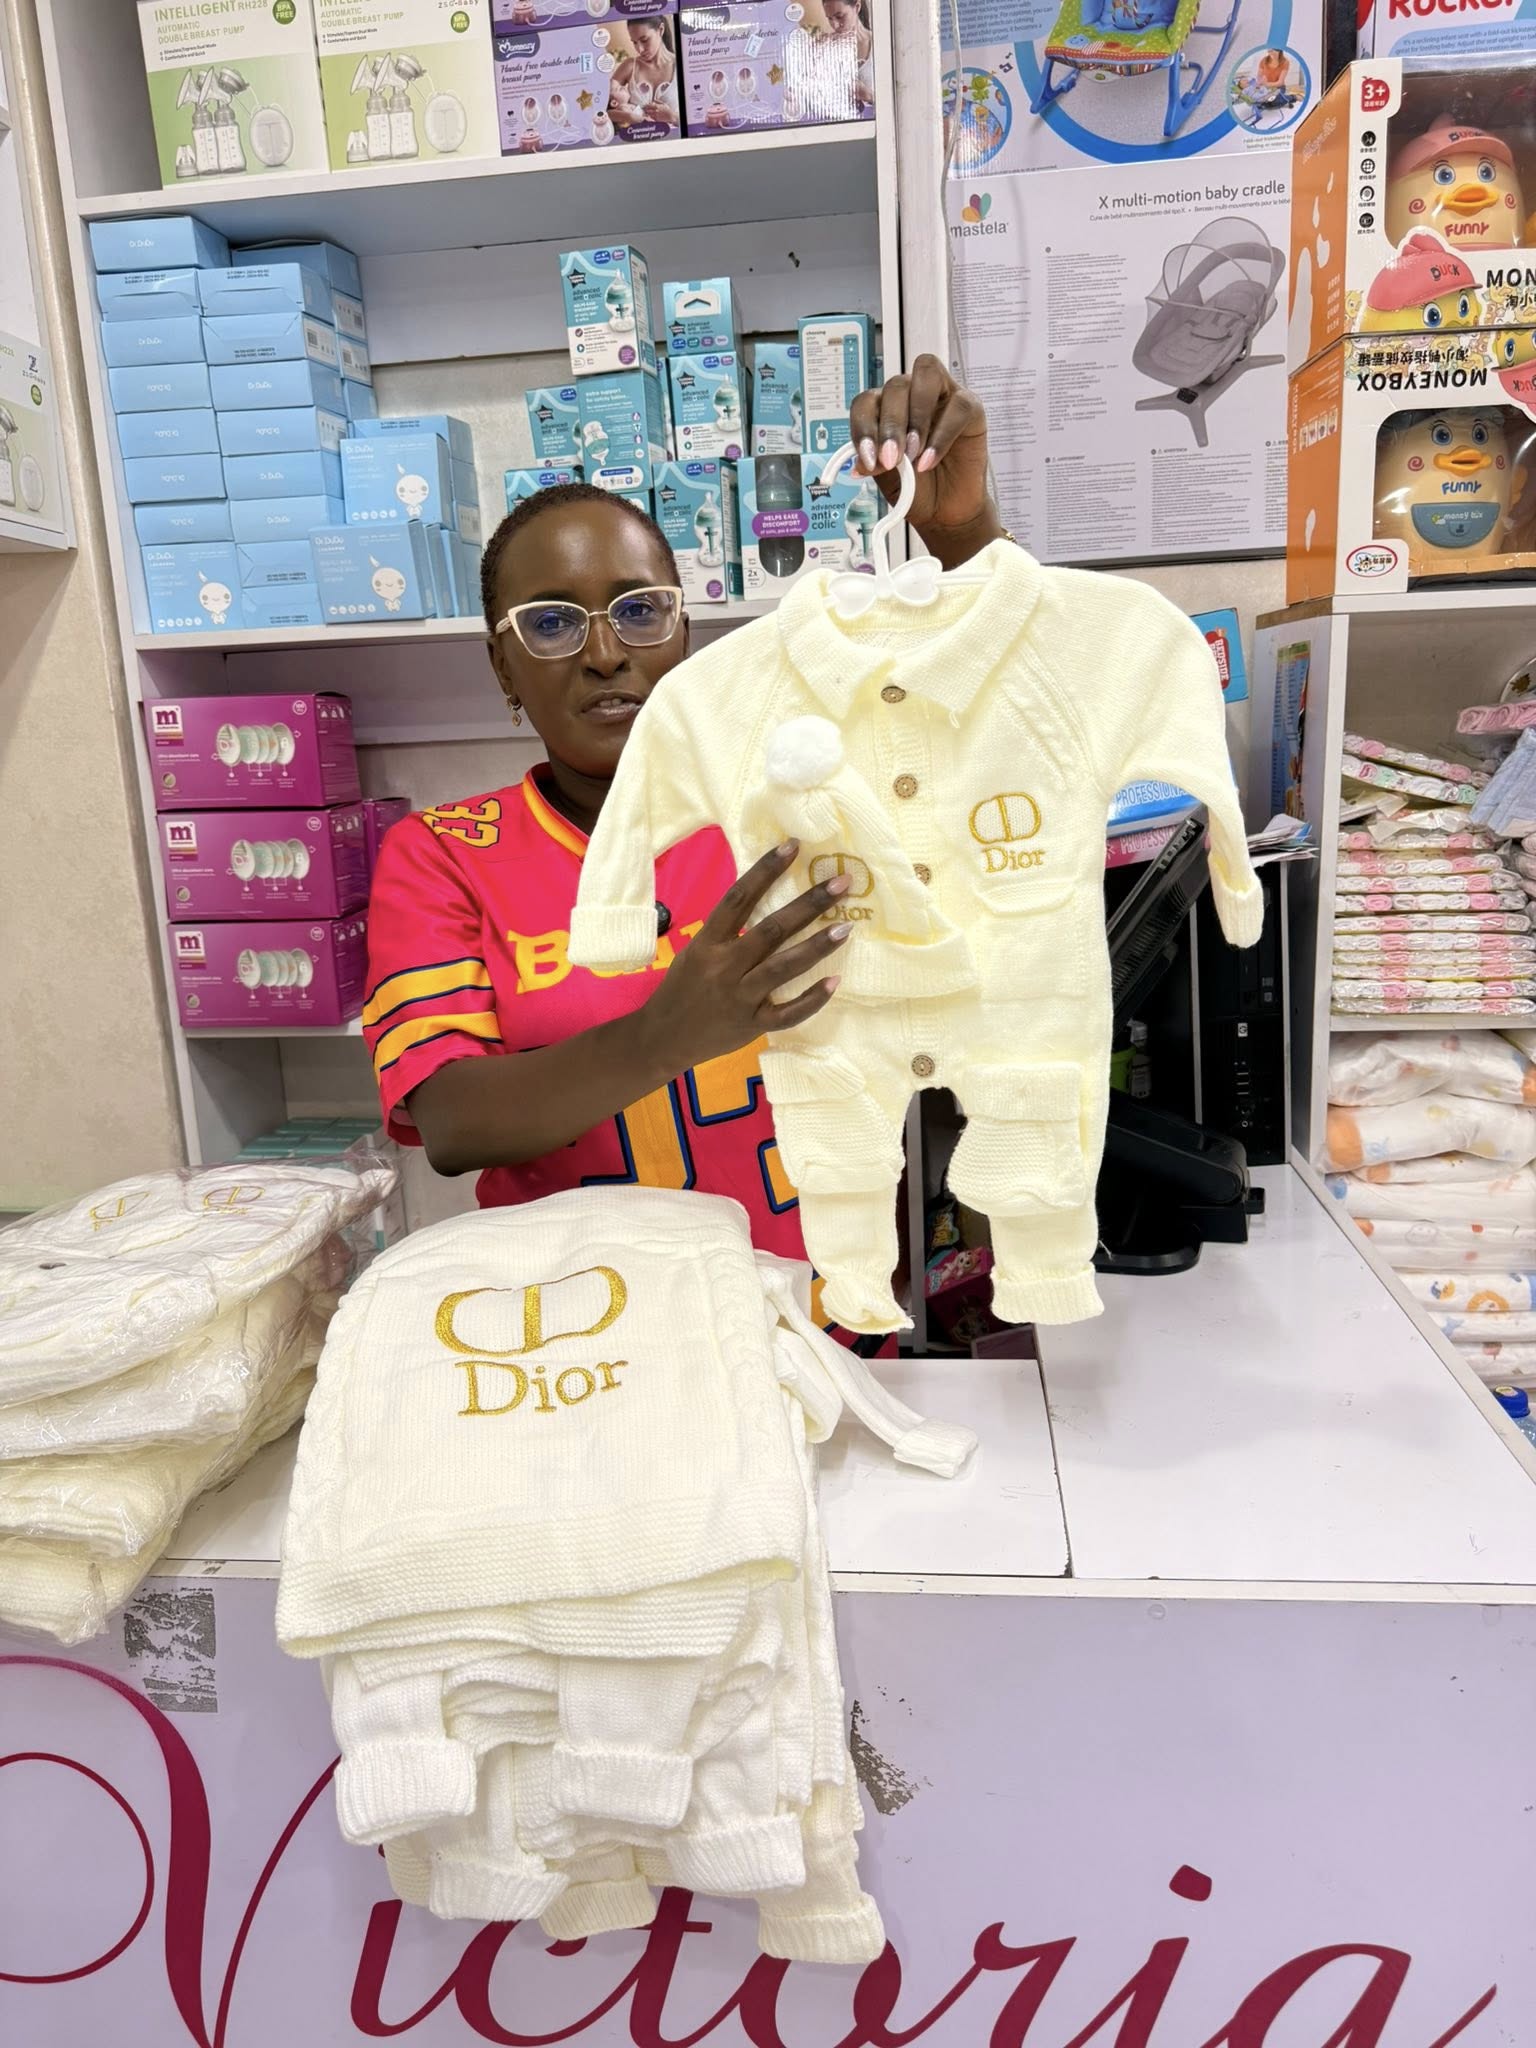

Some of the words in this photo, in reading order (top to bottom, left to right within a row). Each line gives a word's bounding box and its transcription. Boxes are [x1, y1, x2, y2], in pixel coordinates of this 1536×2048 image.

[154, 1, 236, 22] INTELLIGENT
[276, 11, 294, 19] FREE
[277, 3, 291, 12] BPA
[321, 7, 362, 19] AUTOMATIC
[157, 21, 200, 34] AUTOMATIC
[321, 18, 351, 28] DOUBLE
[352, 14, 381, 25] BREAST
[384, 12, 404, 20] PUMP
[158, 33, 189, 45] DOUBLE
[190, 28, 220, 40] BREAST
[224, 25, 245, 35] PUMP
[712, 34, 728, 46] free
[729, 30, 750, 41] doubl
[688, 48, 709, 57] breast
[711, 46, 730, 56] pump
[524, 61, 539, 73] free
[540, 58, 562, 68] double
[563, 56, 580, 65] elect
[502, 74, 522, 84] breast
[523, 73, 542, 83] pump
[1364, 84, 1386, 99] 3+
[1099, 195, 1109, 209] X
[1112, 188, 1201, 208] multi-motion
[1205, 184, 1238, 201] baby
[1242, 180, 1285, 197] cradle
[950, 221, 1007, 238] mastela
[1430, 264, 1460, 281] DUCK
[1357, 367, 1488, 392] MONEYBOX
[811, 502, 846, 511] advanced
[811, 511, 832, 520] anti
[762, 520, 801, 528] DISCOMFORT
[811, 520, 836, 530] colic
[748, 569, 758, 577] 2x
[983, 847, 1046, 873] Dior
[454, 1360, 629, 1416] Dior
[0, 1654, 1498, 2048] Victoria
